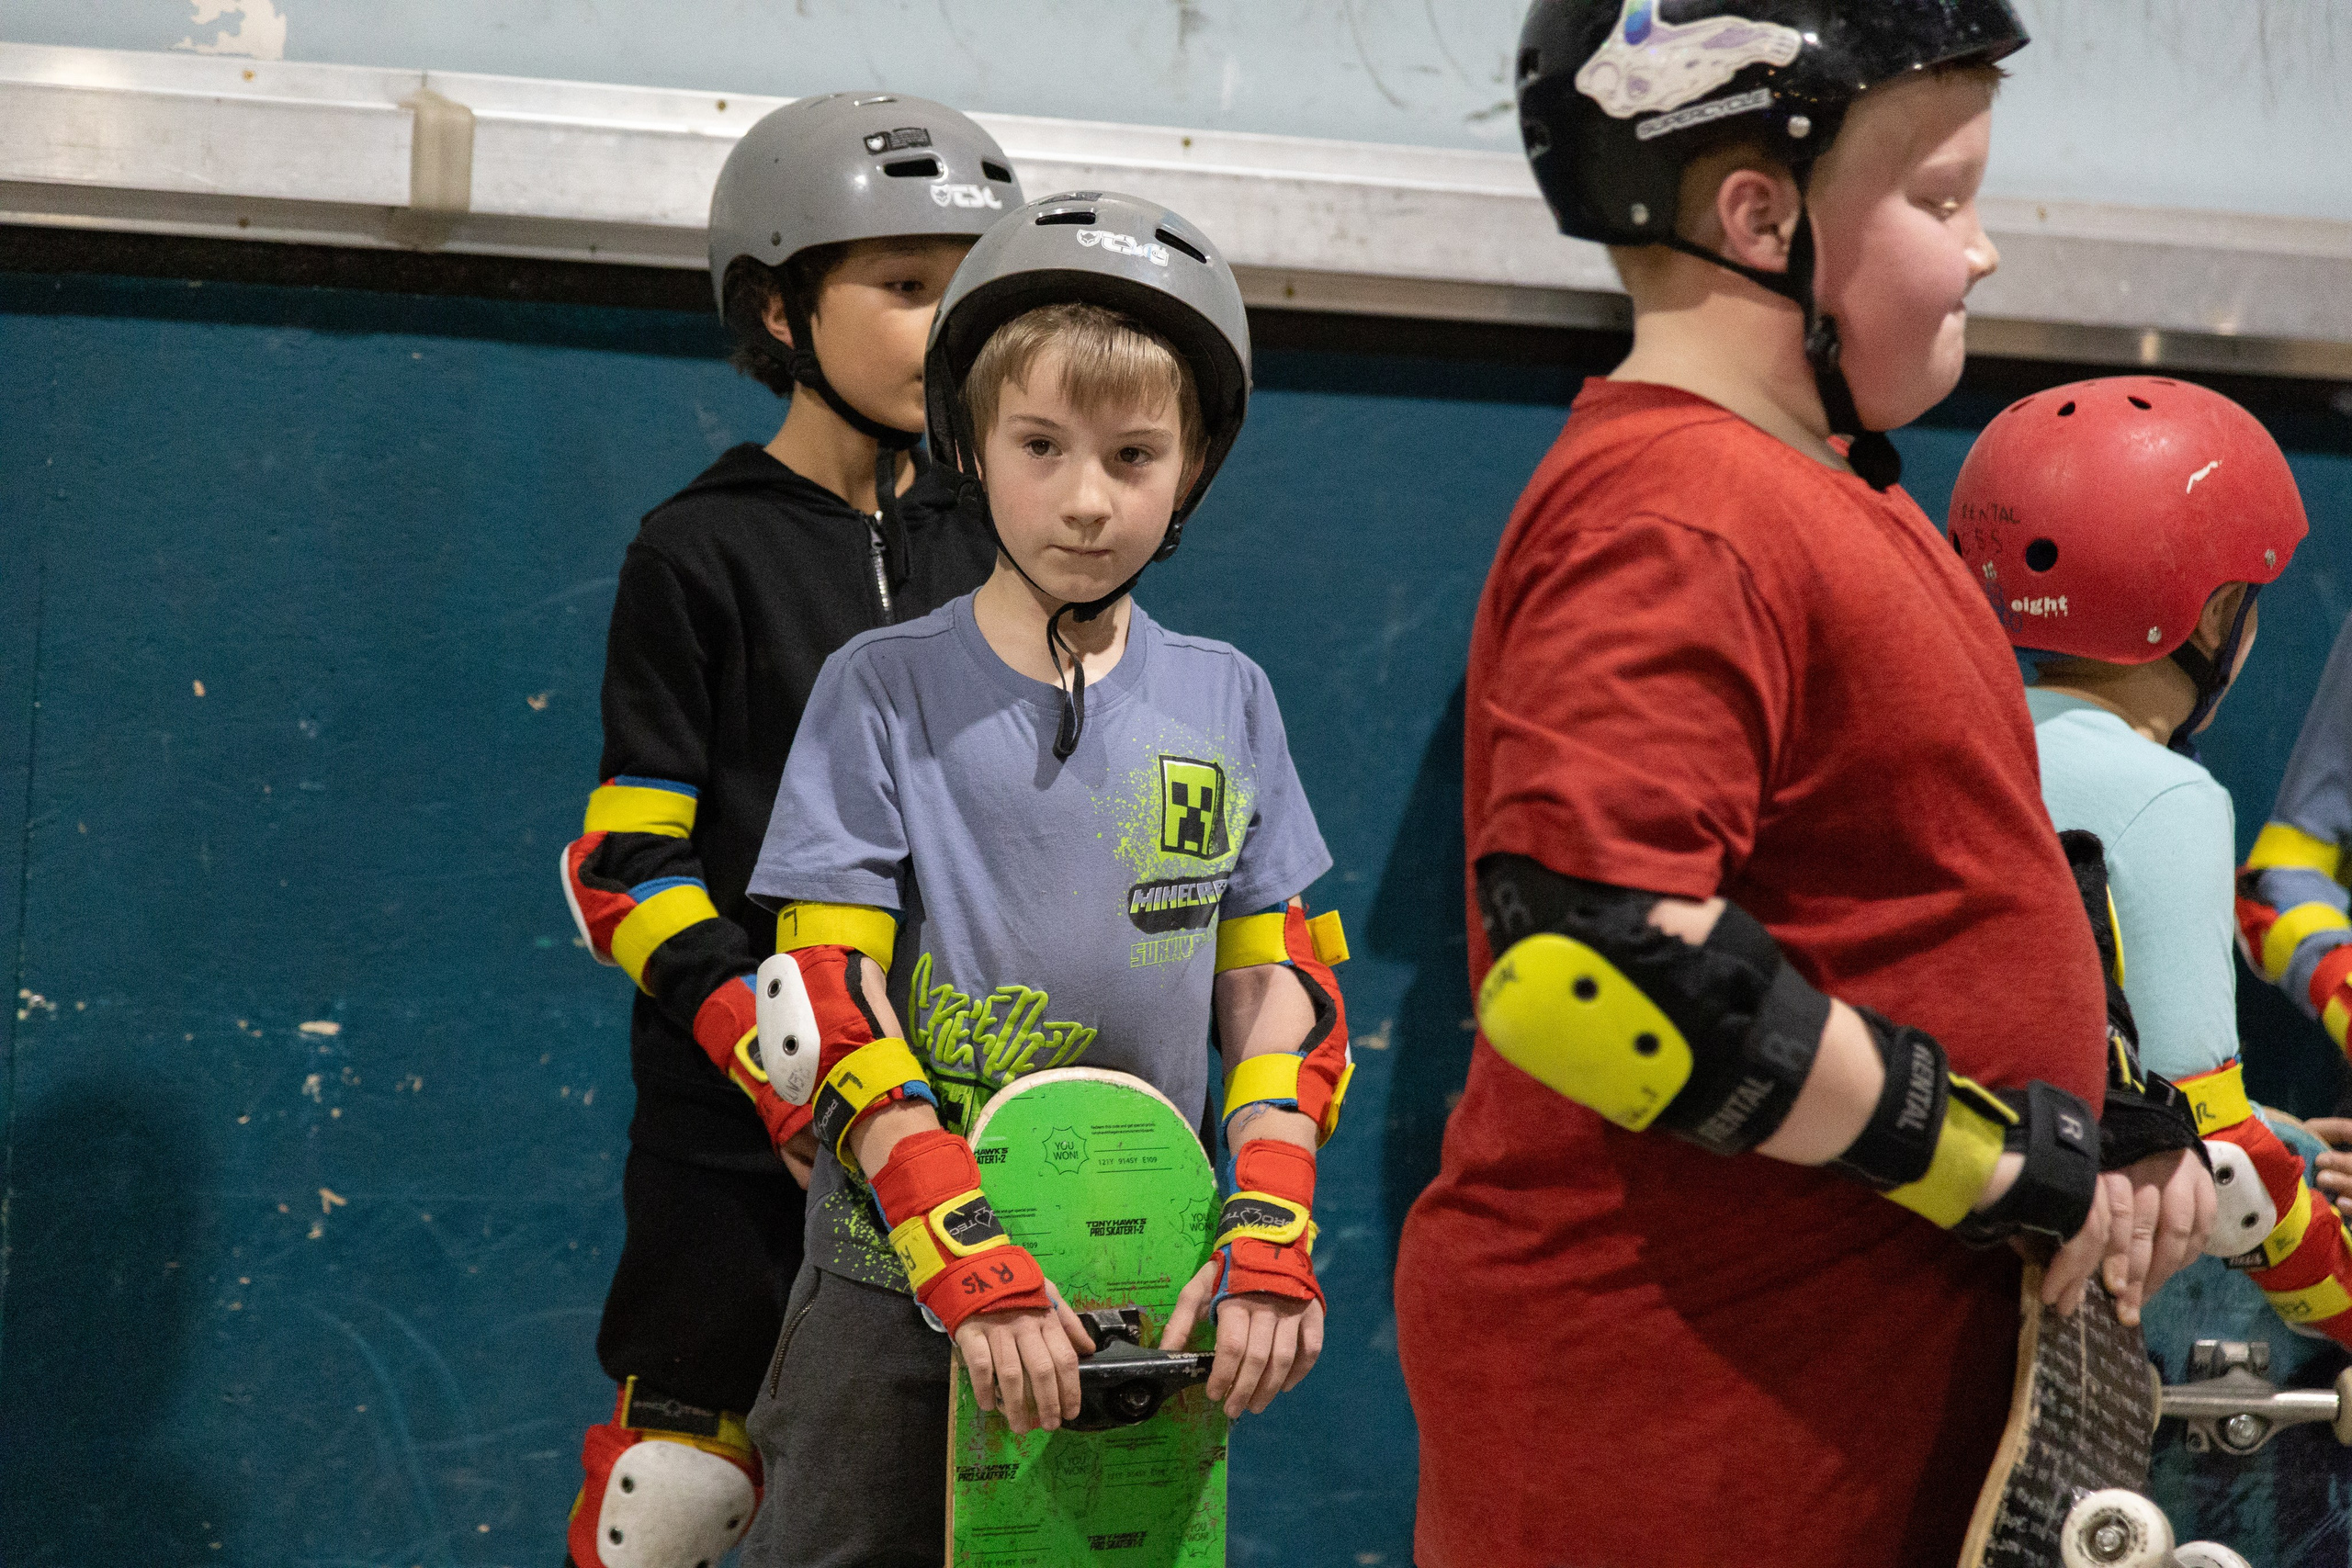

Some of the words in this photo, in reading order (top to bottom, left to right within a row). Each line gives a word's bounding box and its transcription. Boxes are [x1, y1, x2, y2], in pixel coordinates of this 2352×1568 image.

[2011, 594, 2068, 618] eight
[1895, 1043, 1935, 1131] RENTAL
[1055, 1141, 1074, 1150] YOU
[1053, 1151, 1079, 1160] WON!
[1086, 1219, 1113, 1228] TONY
[1113, 1218, 1148, 1226] HAWK'S
[1090, 1227, 1105, 1236] PRO
